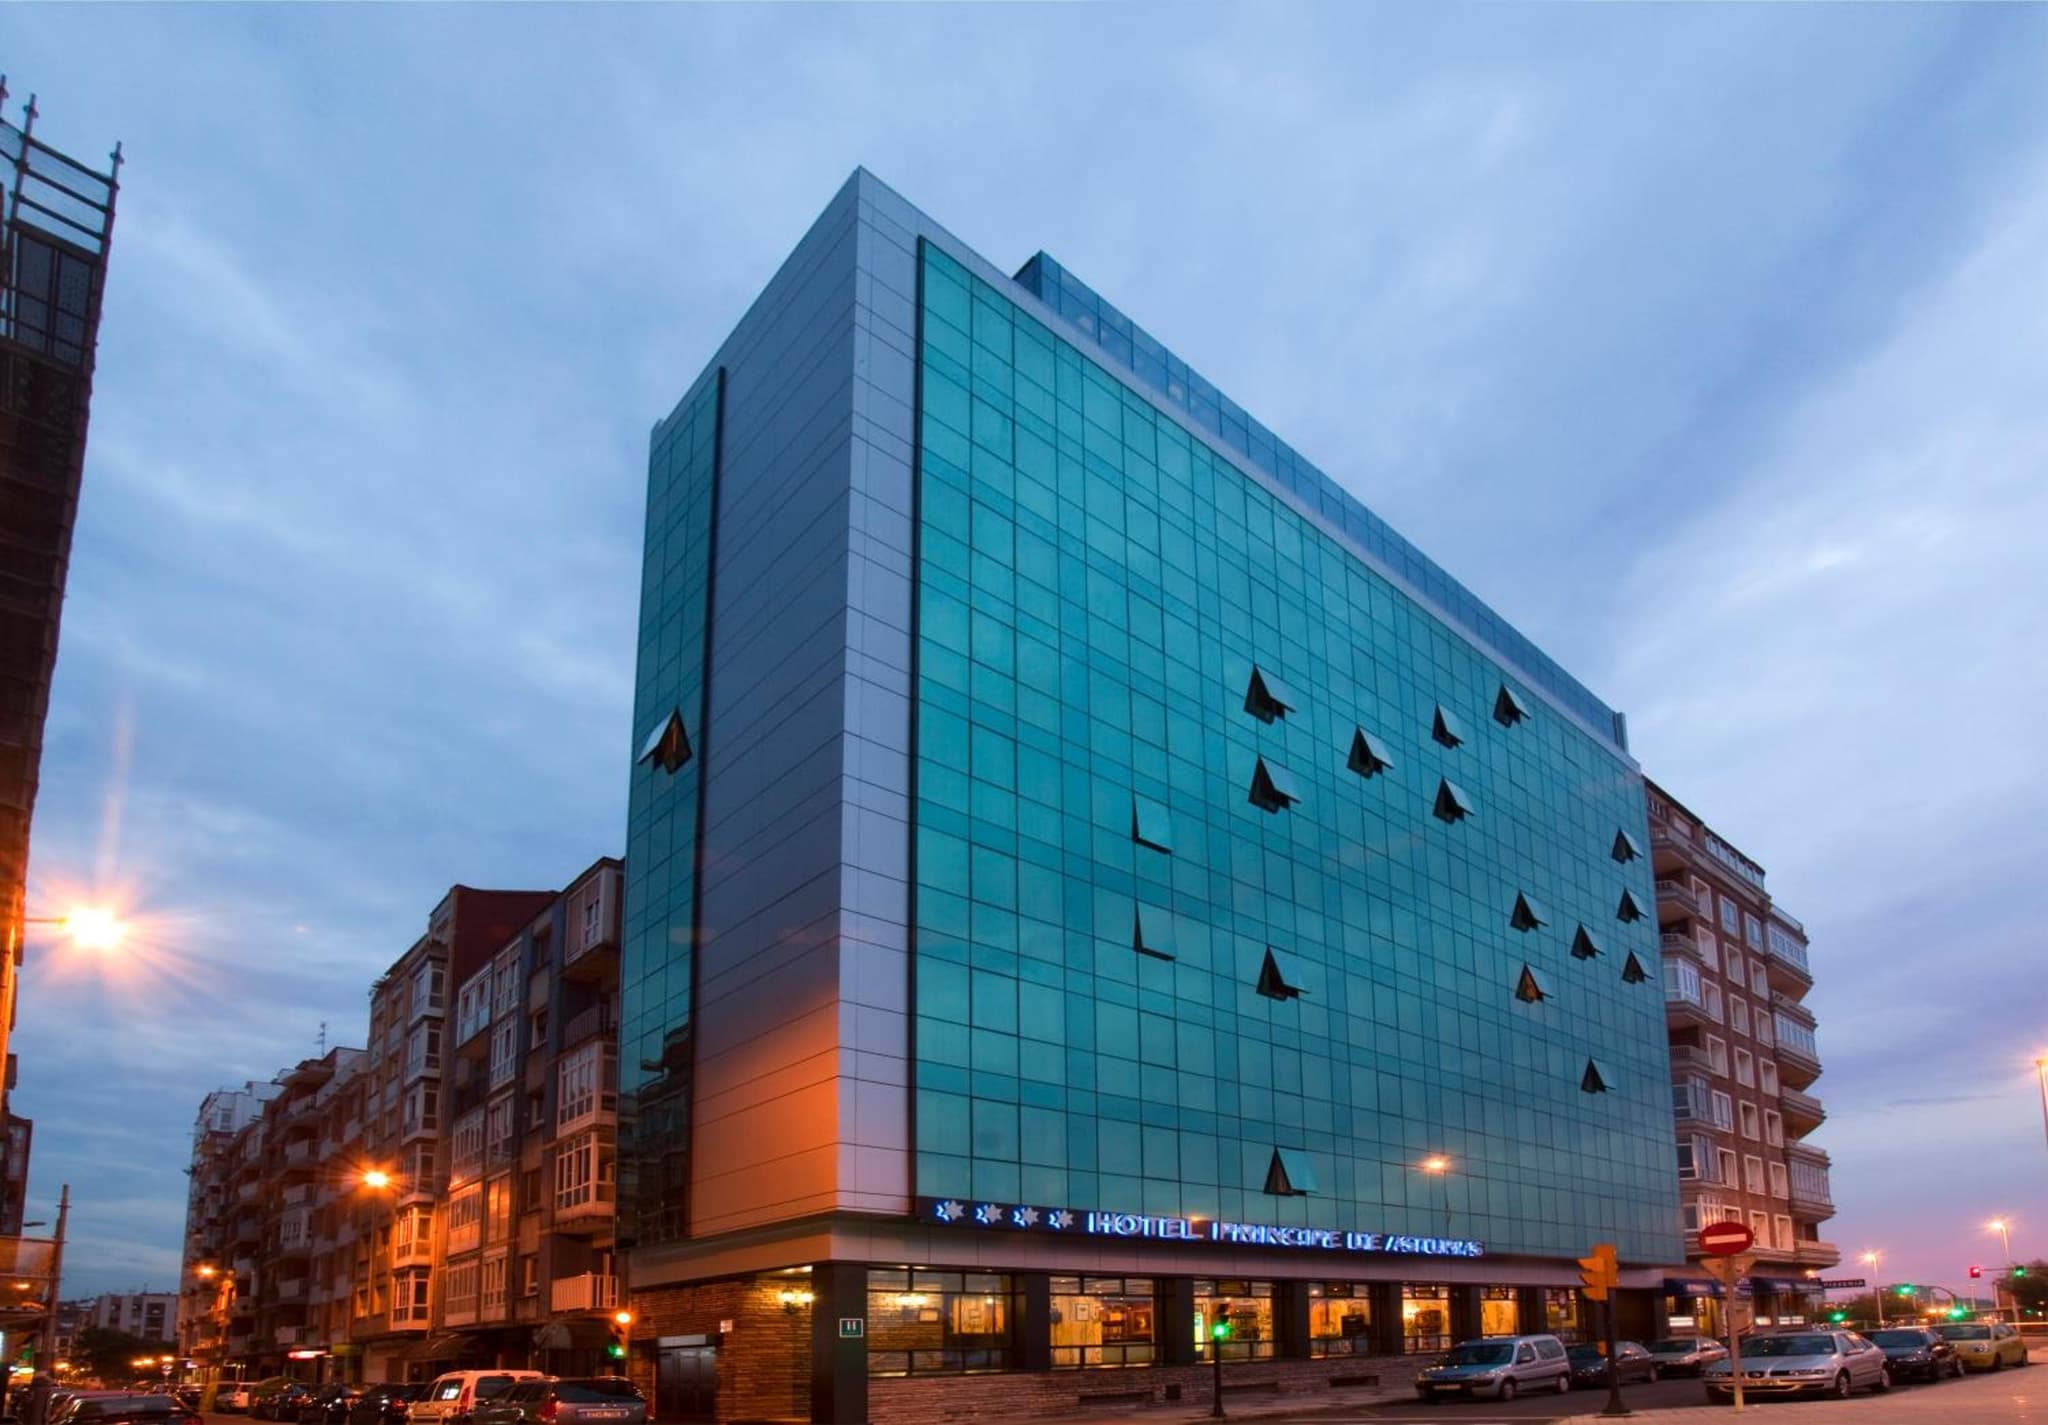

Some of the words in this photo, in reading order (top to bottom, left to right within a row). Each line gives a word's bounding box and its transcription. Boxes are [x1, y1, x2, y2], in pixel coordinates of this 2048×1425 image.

[1088, 1212, 1204, 1239] HOTEL
[1212, 1222, 1342, 1248] PRINCIPE
[1347, 1231, 1382, 1250] DE
